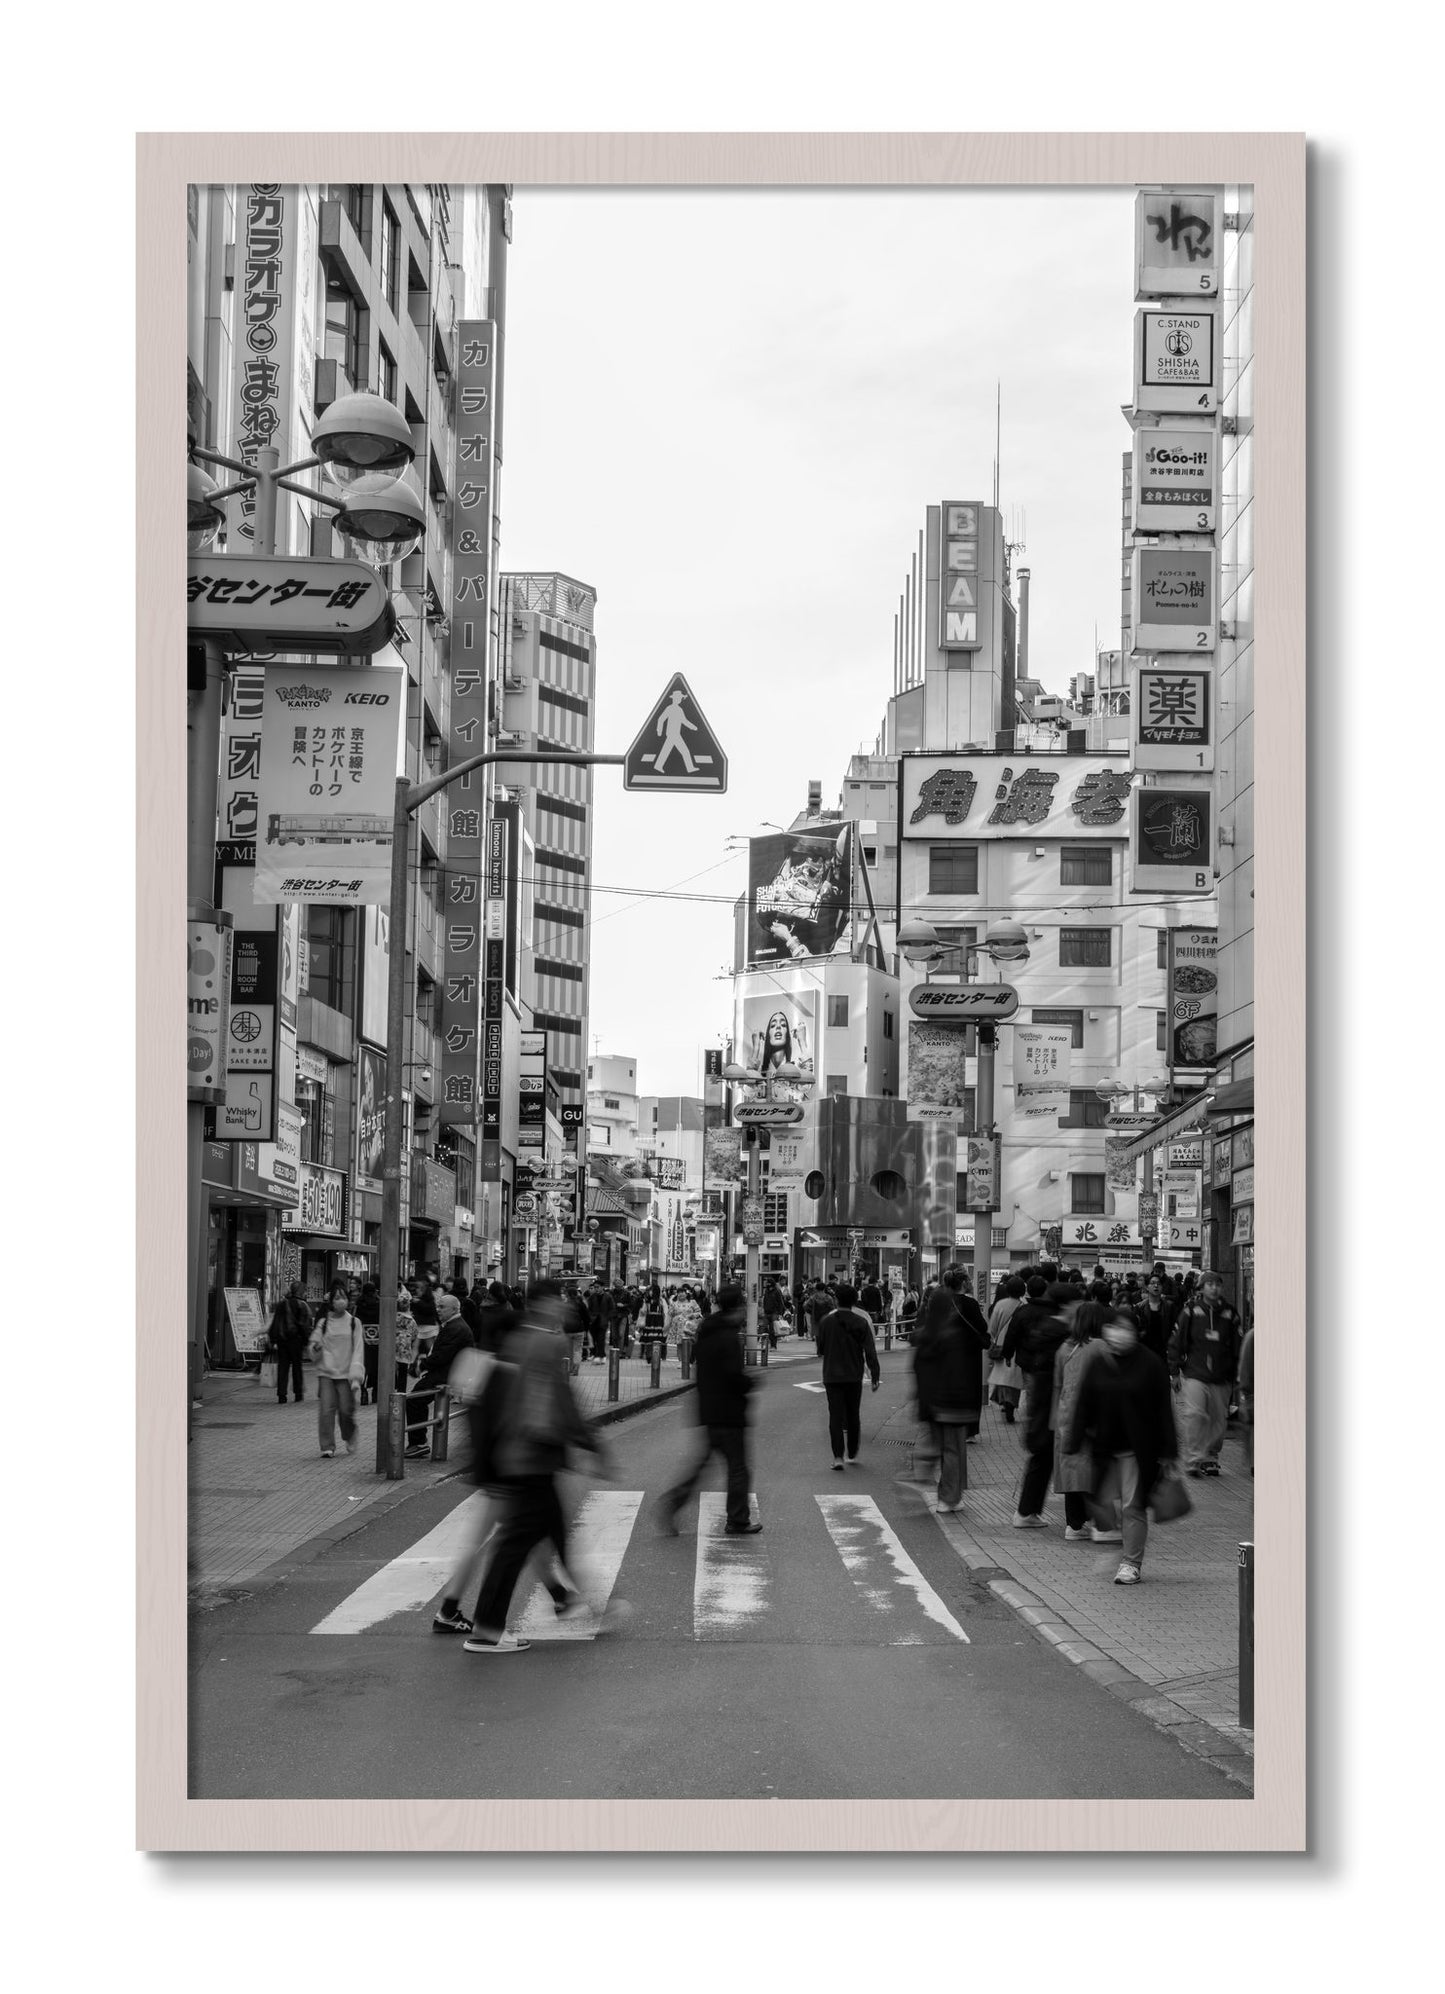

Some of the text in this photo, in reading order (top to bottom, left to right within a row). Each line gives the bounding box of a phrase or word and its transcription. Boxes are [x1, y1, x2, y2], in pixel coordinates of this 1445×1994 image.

[246, 196, 284, 324] カラオケ
[1200, 275, 1212, 289] 5
[1157, 320, 1200, 329] C.STAND
[1157, 358, 1200, 368] SHISHA
[1145, 491, 1209, 502] 全身もみほぐし
[1197, 512, 1209, 528] 3
[947, 507, 978, 642] BEAM
[1196, 632, 1208, 647] 2
[287, 700, 321, 708] KANTO
[344, 693, 390, 706] KEIO
[1148, 677, 1196, 725] 薬
[291, 726, 307, 766] 冒険へ
[309, 726, 326, 796] カントーの
[348, 727, 365, 783] 京王線で
[1196, 752, 1204, 767] 1
[908, 768, 1131, 825] 角海老
[1143, 804, 1201, 850] 一蘭
[493, 823, 502, 857] kimono
[280, 879, 364, 891] 渋谷センター街
[1195, 872, 1206, 888] B
[237, 949, 259, 957] THIRD
[443, 876, 478, 1104] カラオケ館
[916, 992, 1012, 1006] 渋谷センター街
[1174, 1001, 1201, 1020] 6F
[226, 1107, 257, 1118] Whisky
[563, 1110, 582, 1121] GU
[737, 1107, 796, 1116] 渋谷センター街
[225, 1116, 245, 1124] Bank
[1075, 1222, 1131, 1243] 兆楽
